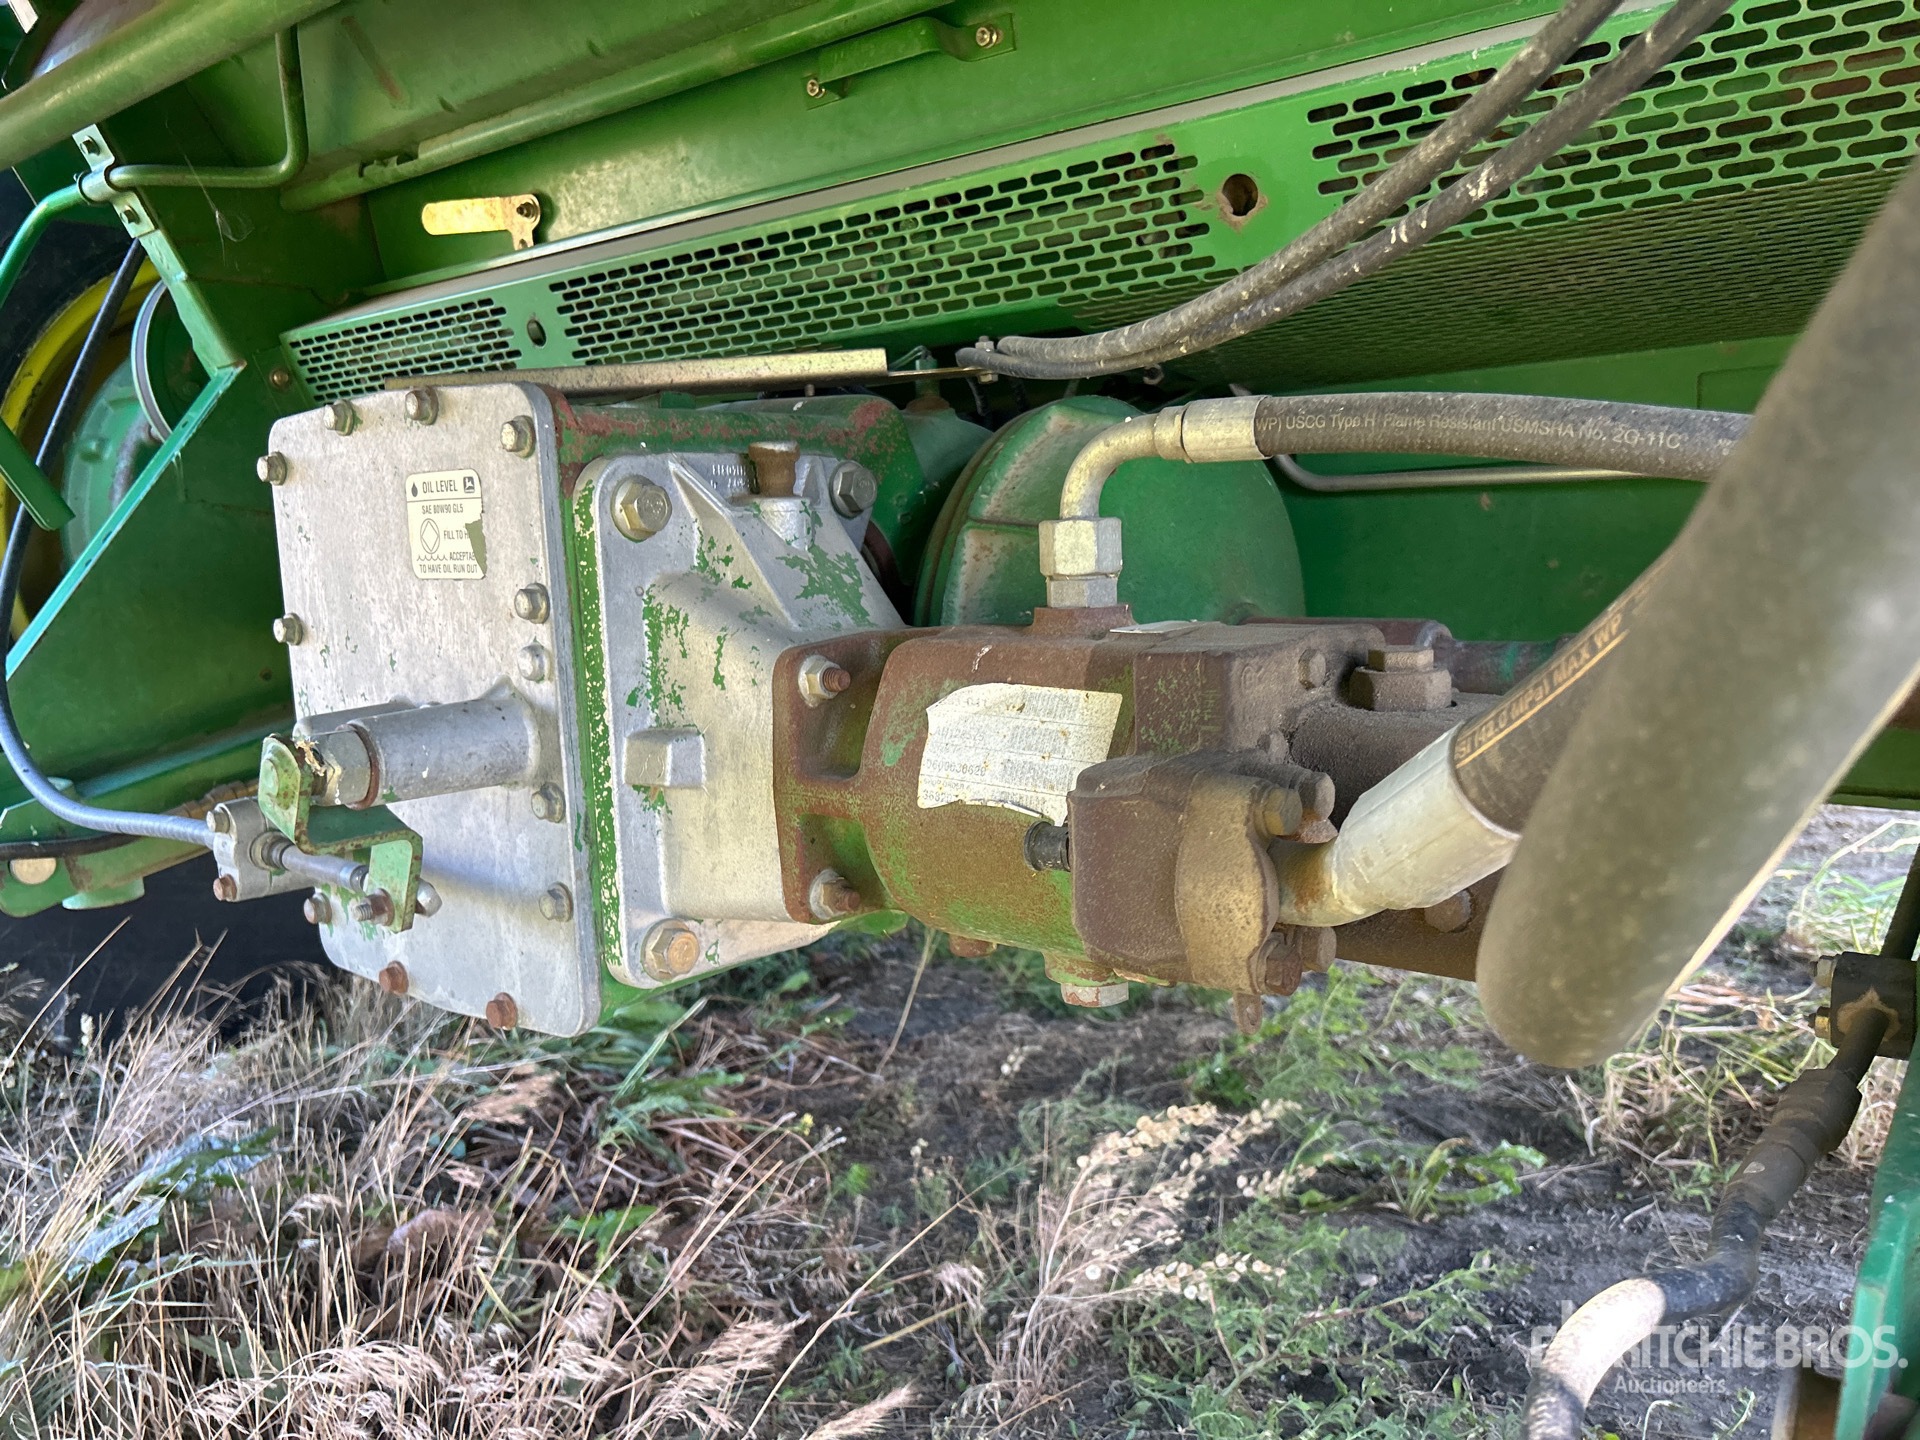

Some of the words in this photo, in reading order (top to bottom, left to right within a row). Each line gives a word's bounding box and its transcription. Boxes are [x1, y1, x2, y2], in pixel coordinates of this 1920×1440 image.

[1286, 414, 1326, 430] USCG
[1330, 412, 1360, 431] Type
[1429, 414, 1498, 431] Resistant
[422, 481, 434, 494] OIL
[435, 479, 458, 493] LEVEL
[421, 504, 432, 515] SAE
[452, 502, 464, 514] GL5
[443, 529, 455, 540] FILL
[455, 529, 464, 540] TO
[419, 563, 427, 574] TO
[427, 563, 441, 574] HAVE
[442, 563, 452, 574] OIL
[453, 563, 465, 574] RUN
[466, 563, 478, 574] OUT
[1552, 642, 1592, 687] MAX
[1594, 612, 1623, 651] WP
